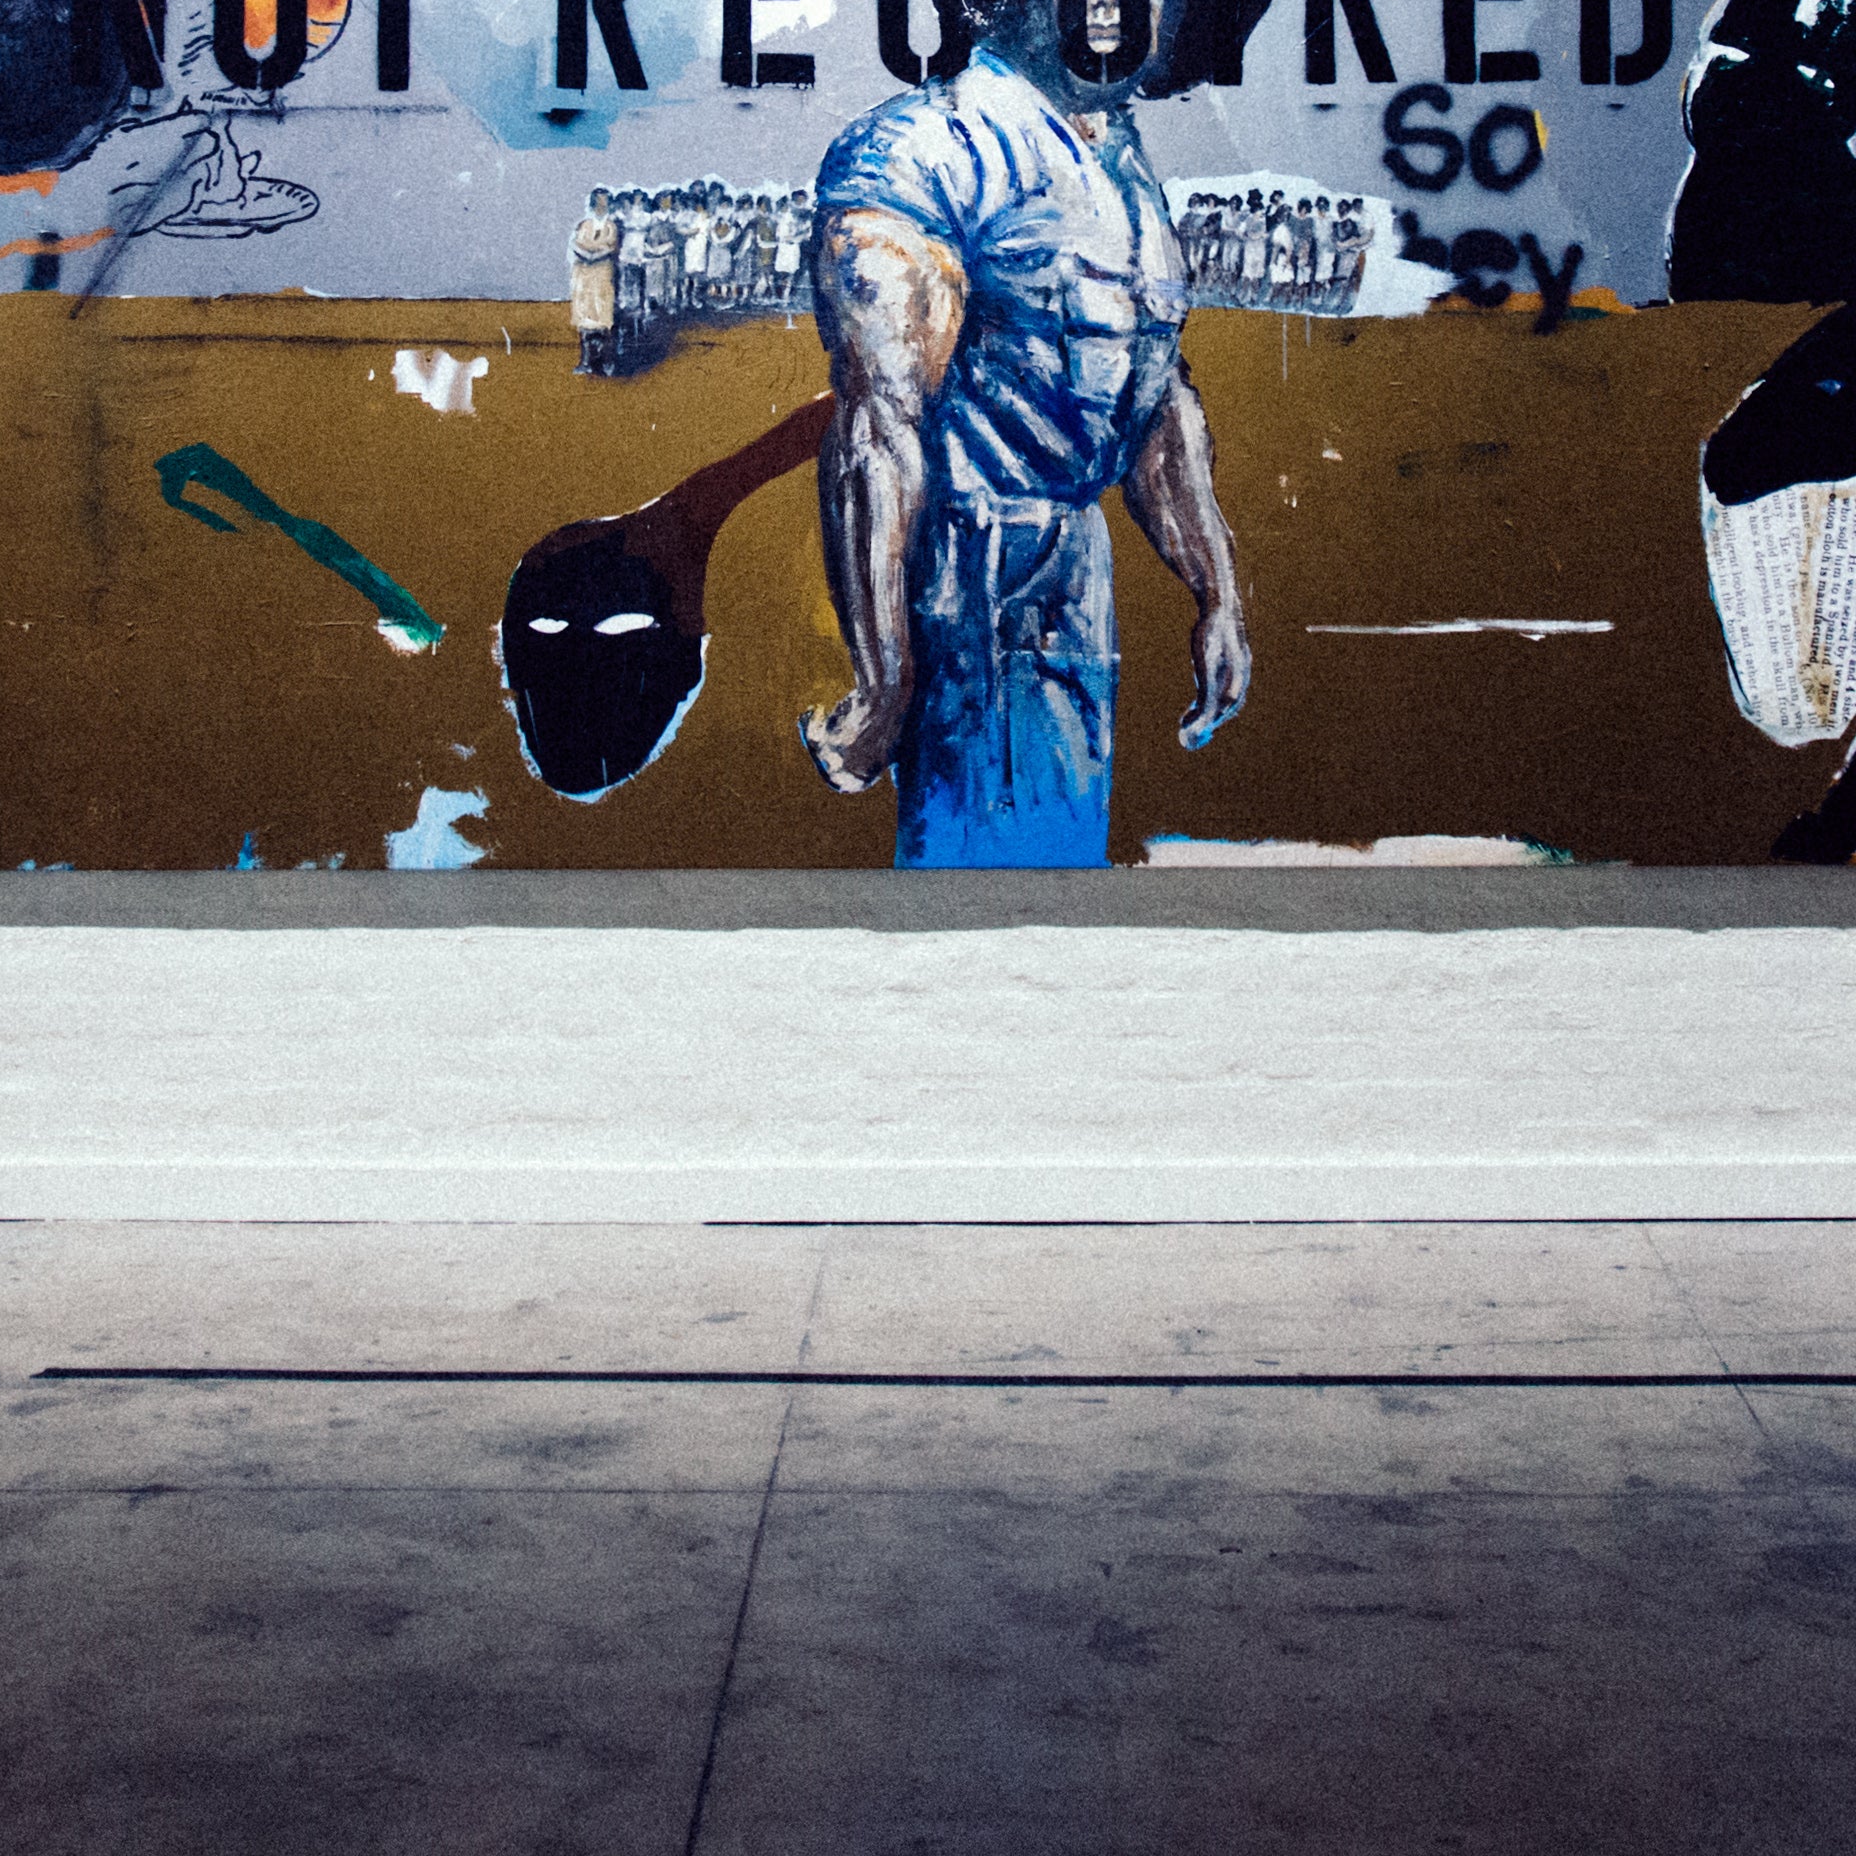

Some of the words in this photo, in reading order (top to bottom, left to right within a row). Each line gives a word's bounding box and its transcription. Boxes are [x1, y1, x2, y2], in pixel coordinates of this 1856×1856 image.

[1760, 505, 1772, 530] who
[1800, 496, 1811, 529] name
[1824, 493, 1837, 530] cotton
[1840, 498, 1852, 522] who
[1749, 516, 1760, 536] has
[1765, 534, 1778, 558] sold
[1779, 536, 1790, 555] He
[1820, 534, 1834, 563] cloth
[1837, 526, 1848, 550] sold
[1770, 566, 1781, 589] him
[1784, 563, 1792, 572] is
[1820, 567, 1830, 576] is
[1833, 555, 1845, 578] him
[1718, 574, 1727, 586] in
[1754, 551, 1773, 615] depression
[1787, 579, 1798, 598] the
[1831, 583, 1841, 594] to
[1844, 579, 1854, 601] was
[1722, 593, 1733, 612] the
[1776, 593, 1785, 605] to
[1766, 620, 1776, 632] in
[1791, 606, 1801, 626] son
[1839, 605, 1851, 641] seized
[1740, 626, 1754, 648] and
[1770, 636, 1780, 655] the
[1780, 624, 1795, 668] Bullom
[1834, 646, 1848, 659] by
[1746, 654, 1758, 690] rather
[1772, 661, 1786, 691] skull
[1833, 664, 1844, 686] two
[1788, 676, 1799, 707] man,
[1829, 690, 1840, 715] men
[1778, 696, 1790, 726] from
